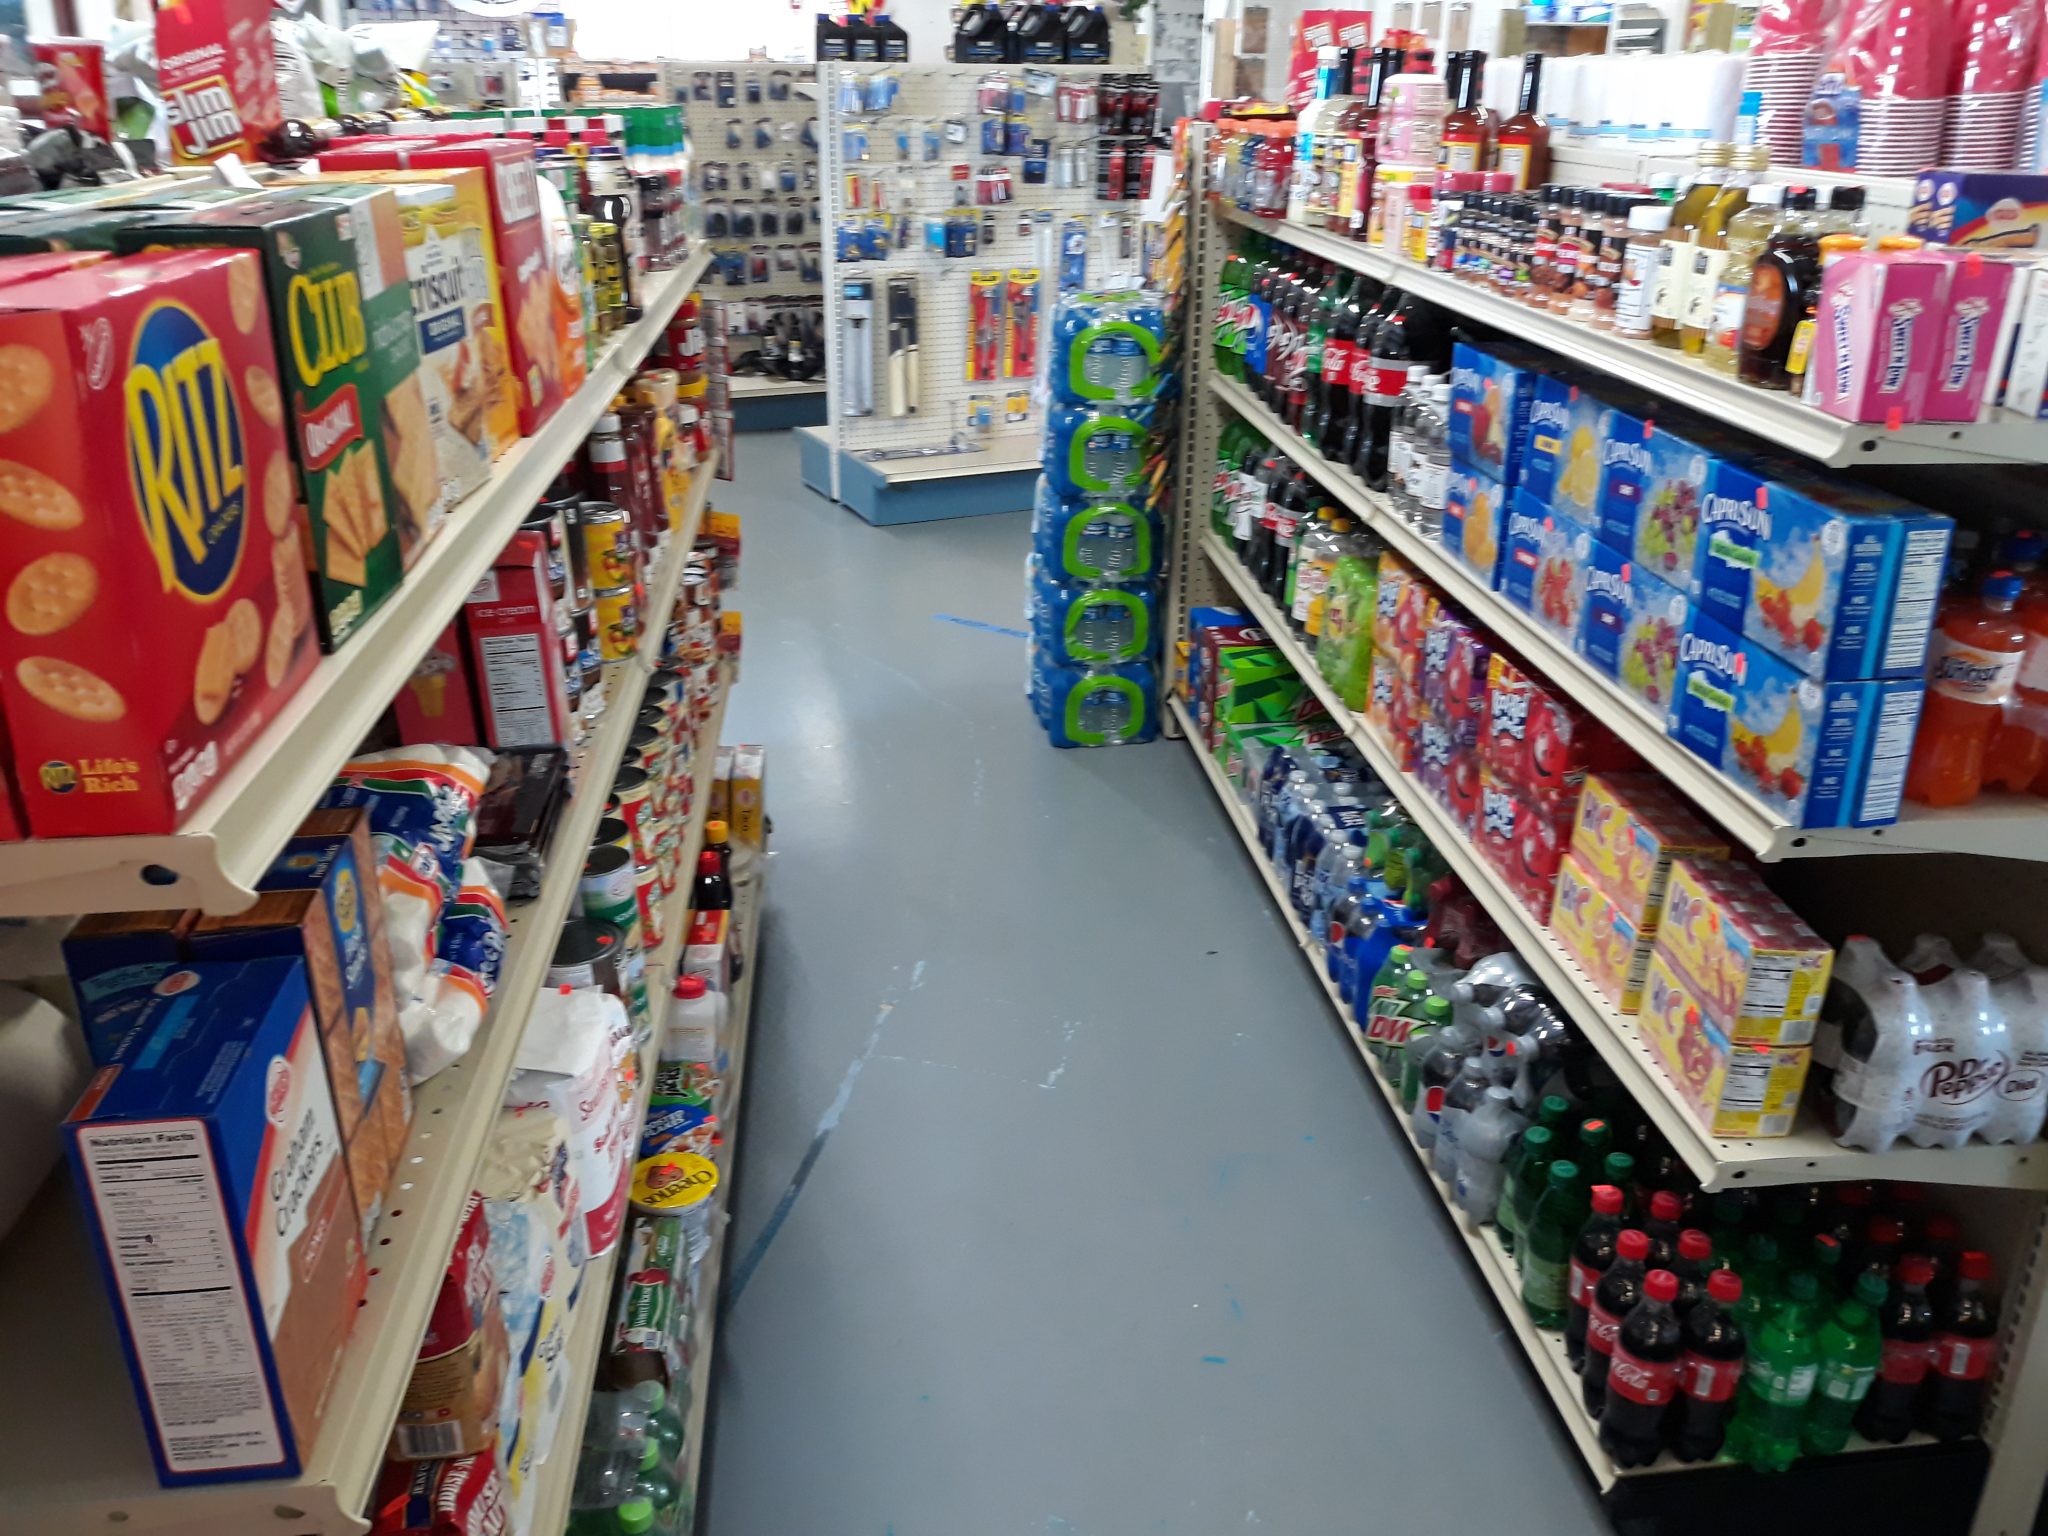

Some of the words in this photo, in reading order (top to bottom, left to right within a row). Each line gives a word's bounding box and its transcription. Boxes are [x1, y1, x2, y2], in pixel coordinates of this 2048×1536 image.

[288, 271, 366, 387] CLUB
[123, 337, 244, 593] RITZ
[78, 757, 141, 775] Life's
[82, 775, 141, 793] Rich
[90, 1135, 152, 1148] Nutrition
[156, 1132, 195, 1144] Facts
